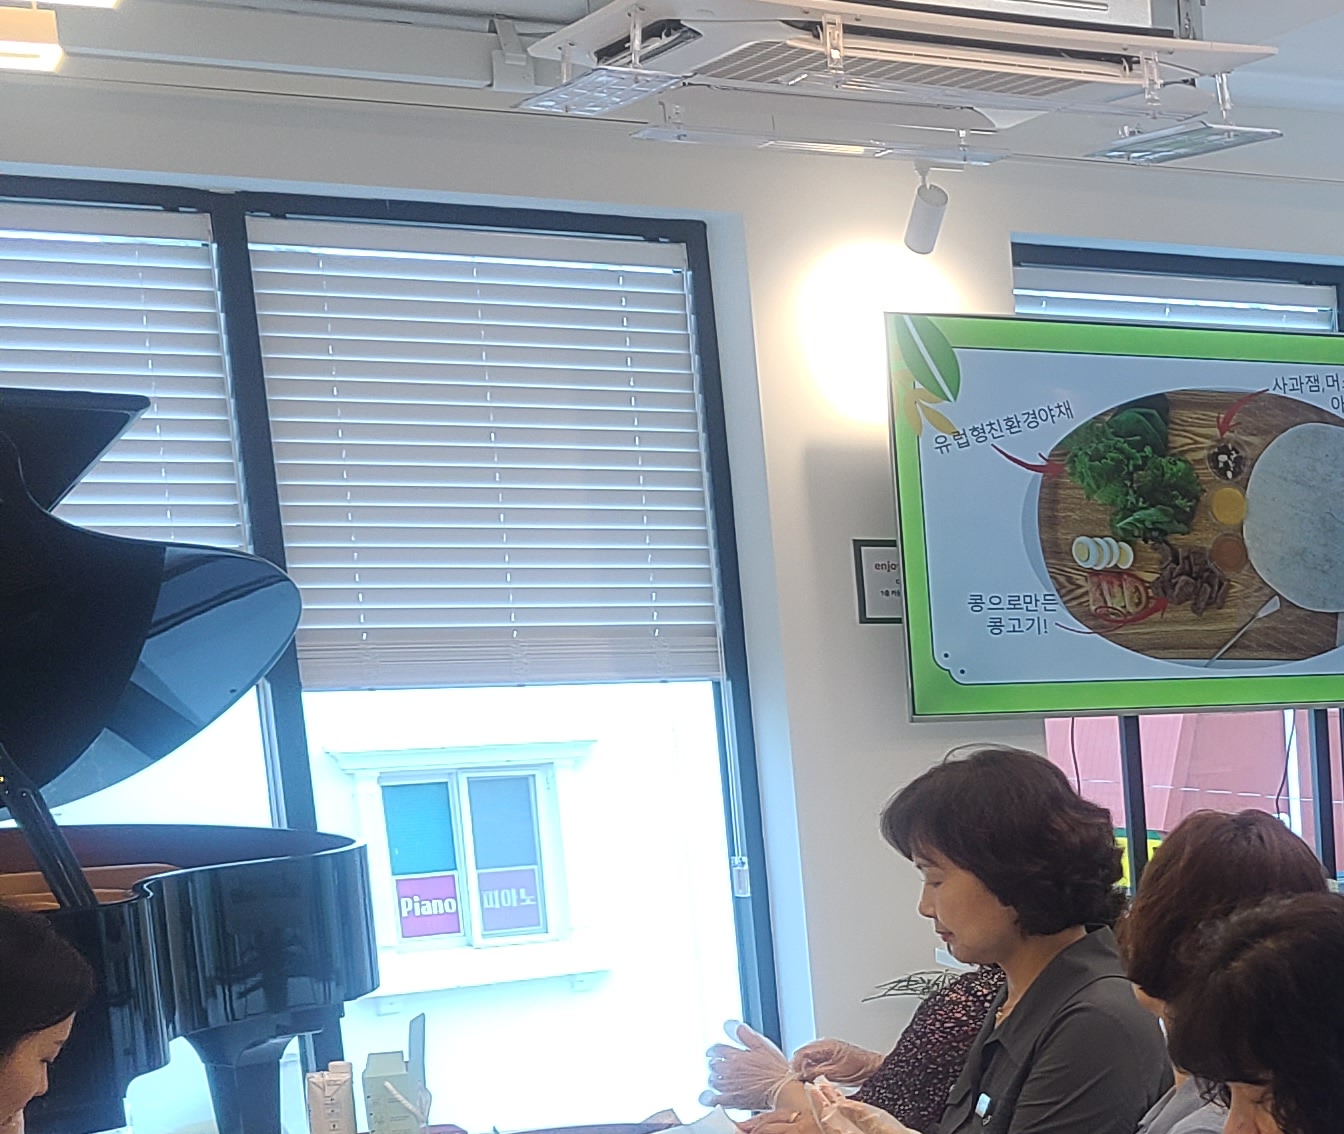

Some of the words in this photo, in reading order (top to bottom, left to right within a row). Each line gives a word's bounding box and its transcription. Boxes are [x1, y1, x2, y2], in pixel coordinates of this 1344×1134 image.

[934, 400, 1074, 455] 유럽형친환경야채
[968, 593, 1059, 613] 콩으로만든
[987, 616, 1048, 635] 콩고기!
[401, 896, 456, 917] Piano
[483, 888, 537, 909] 피아노
